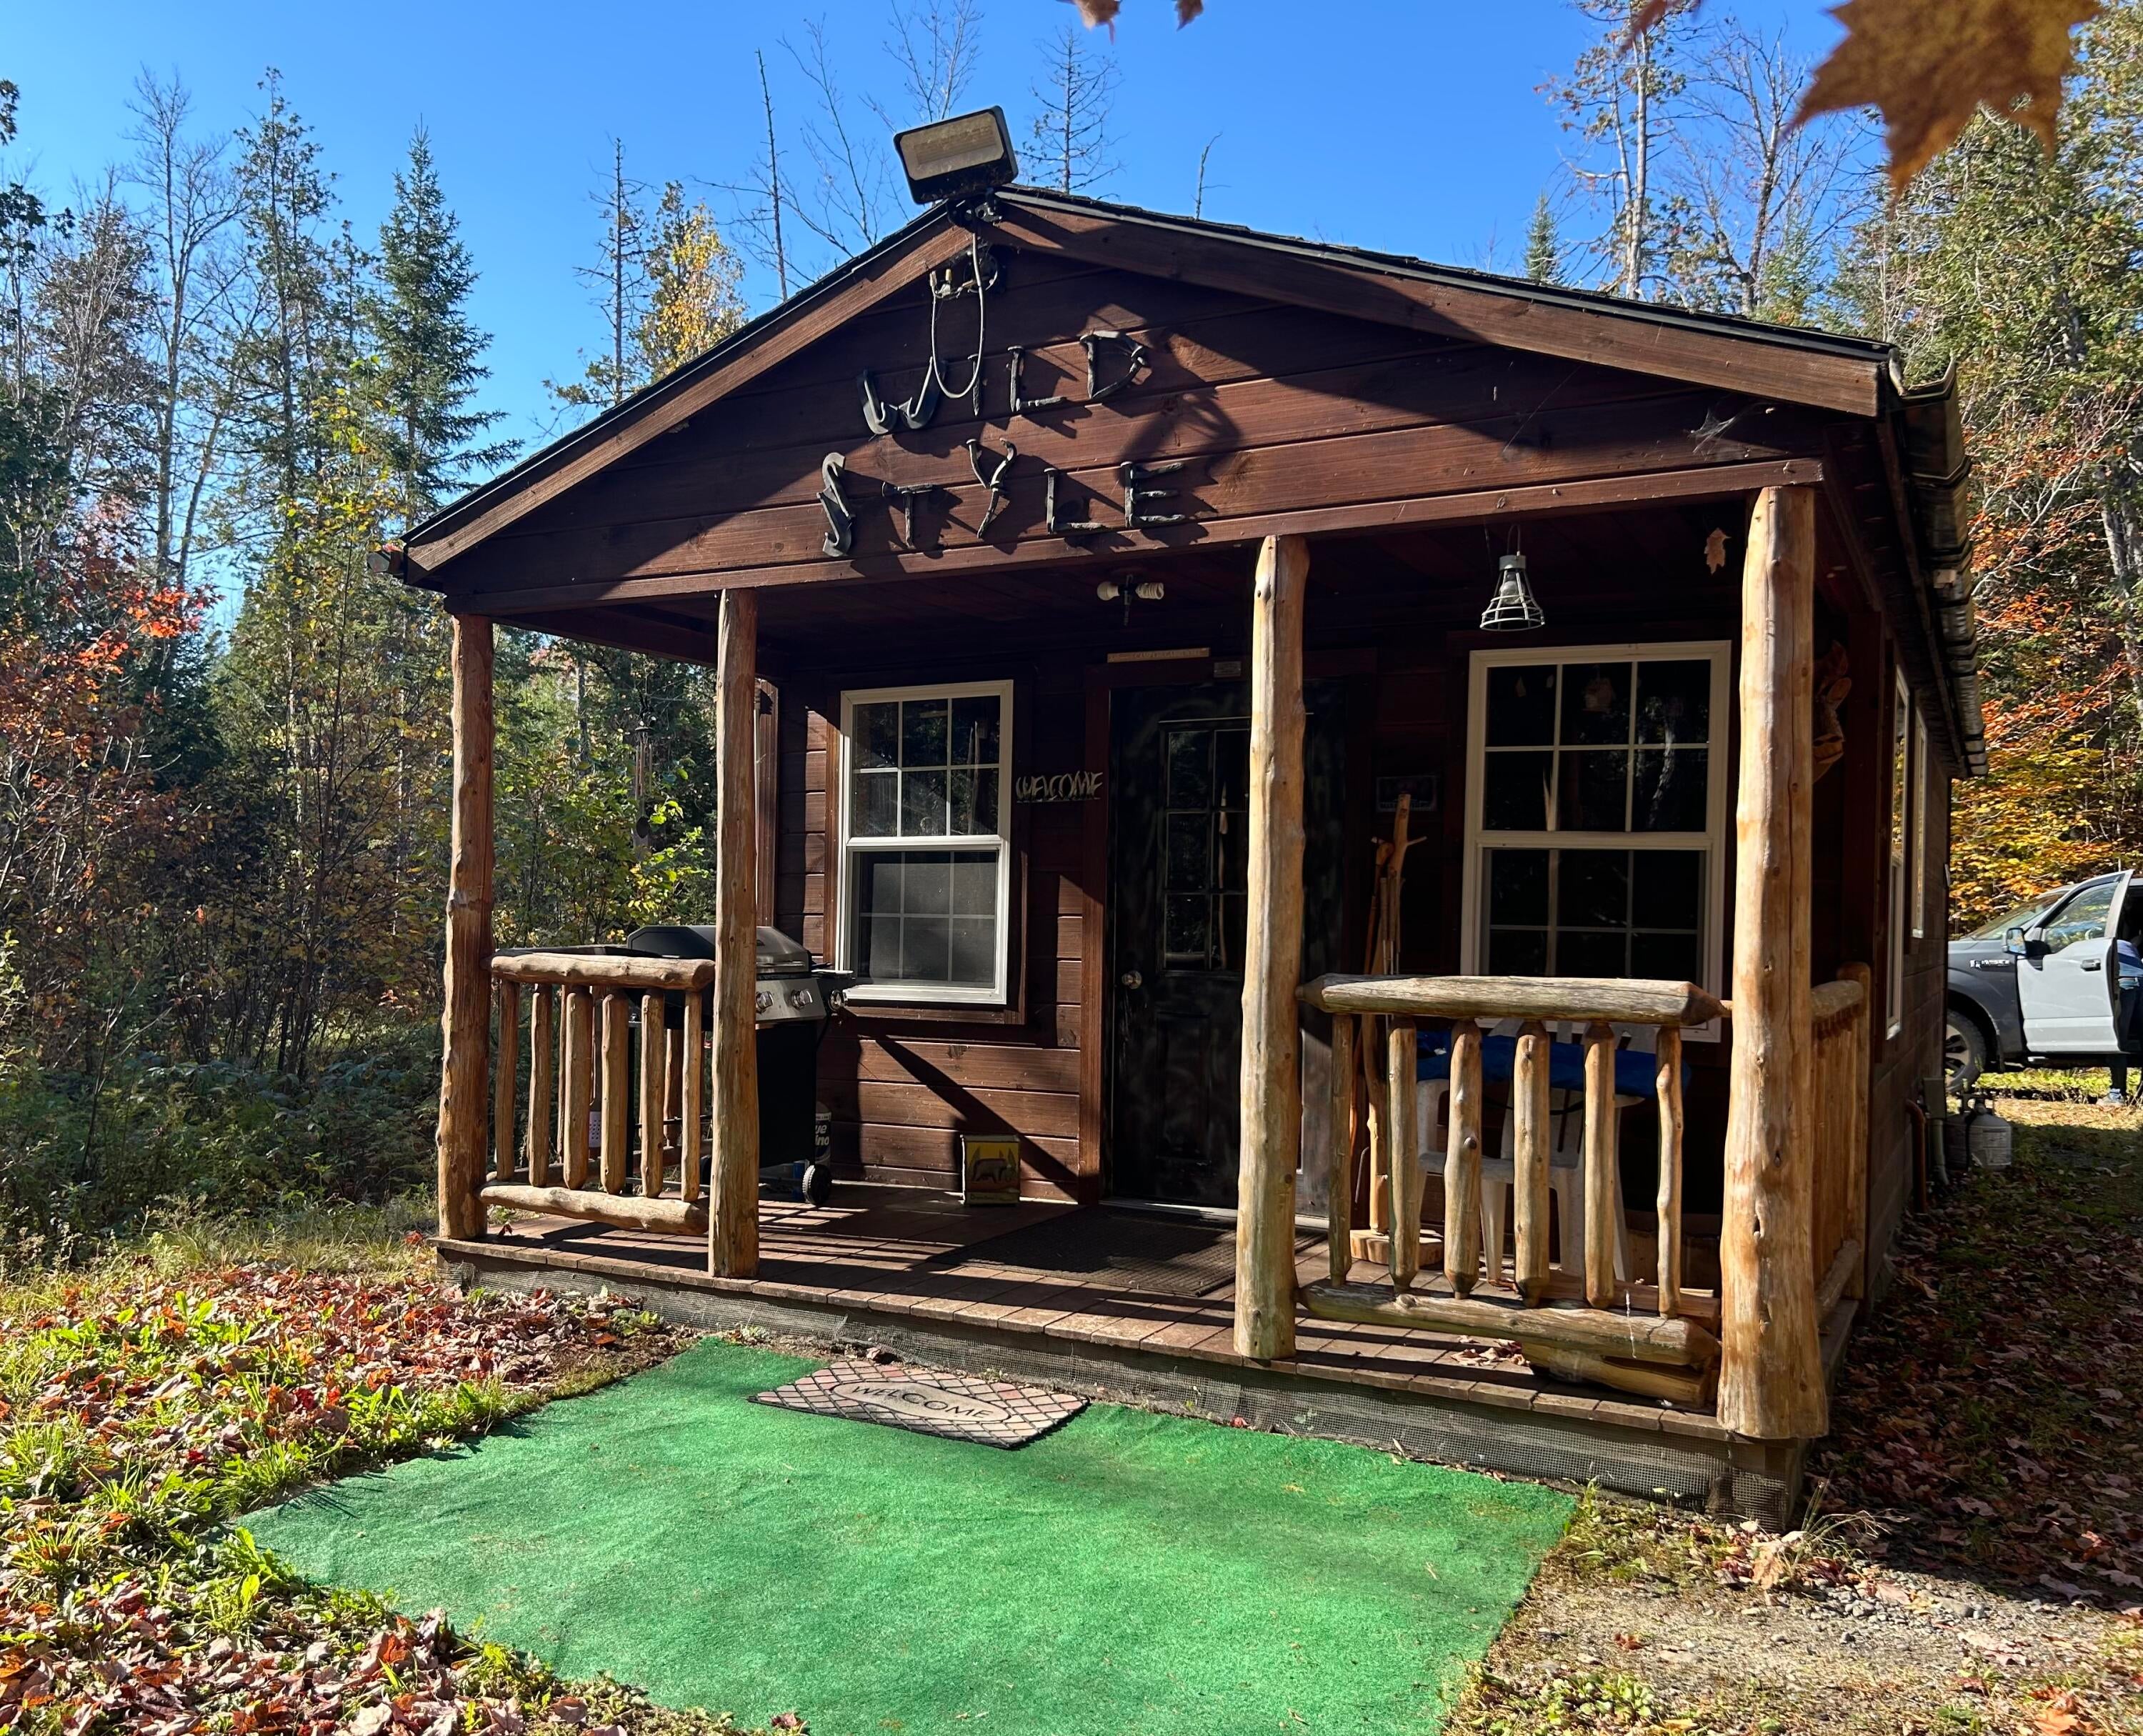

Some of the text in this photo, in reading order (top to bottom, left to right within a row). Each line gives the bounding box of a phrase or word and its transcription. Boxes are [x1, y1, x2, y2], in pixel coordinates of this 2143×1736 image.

[860, 329, 1149, 435] WILD
[816, 437, 1186, 558] STYLE
[1015, 771, 1104, 804] WELCOME
[815, 1124, 827, 1134] ue
[815, 1134, 830, 1146] ino
[851, 1384, 994, 1420] WELCOME
